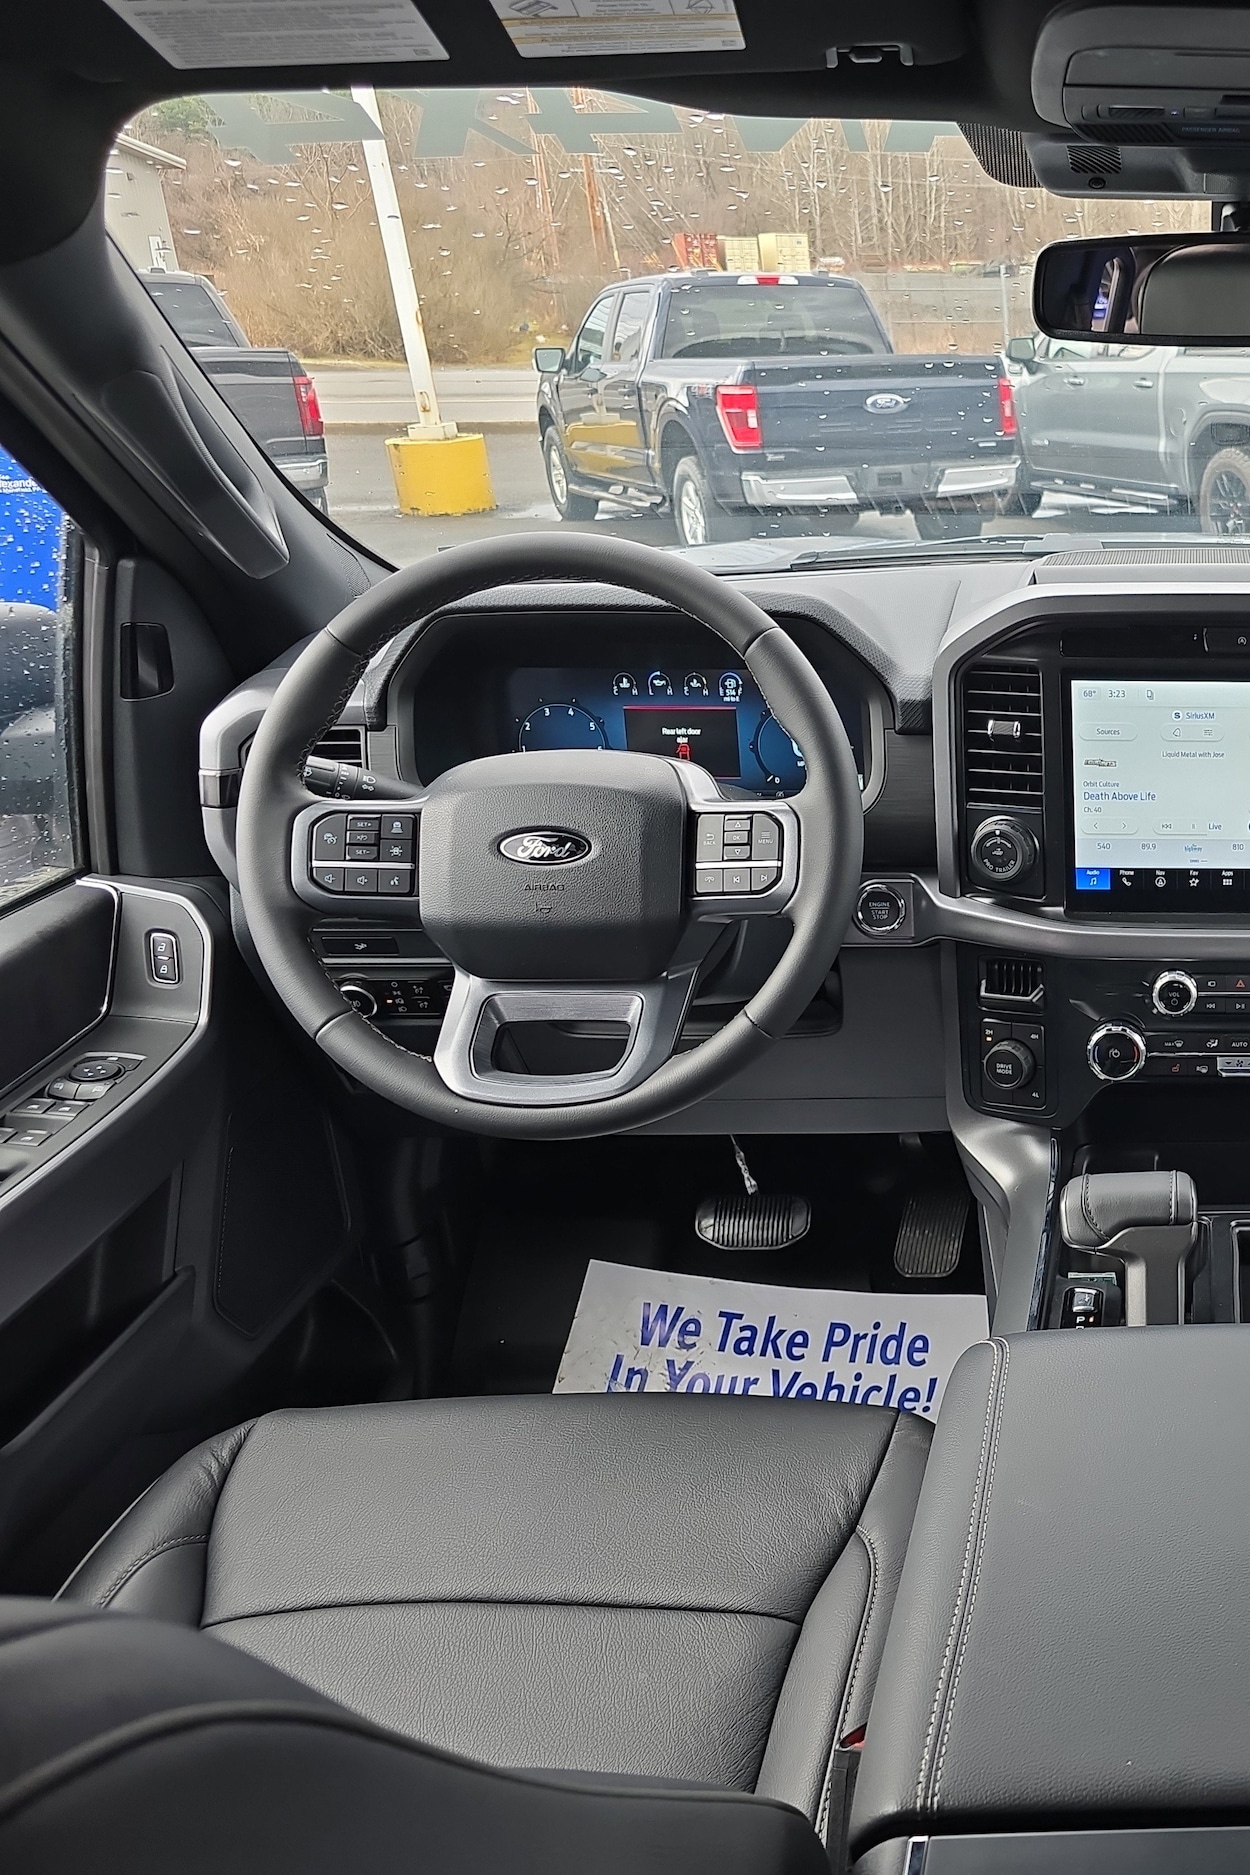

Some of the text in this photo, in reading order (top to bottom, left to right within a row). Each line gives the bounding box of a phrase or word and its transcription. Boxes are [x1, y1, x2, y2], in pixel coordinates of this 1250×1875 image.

[1108, 690, 1126, 698] 3:23
[544, 707, 551, 717] 3
[568, 707, 575, 717] 4
[1185, 711, 1215, 720] SiriusXM
[525, 722, 531, 731] 2
[589, 722, 596, 731] 5
[662, 727, 701, 736] Rear left door
[1096, 727, 1121, 736] Sources
[676, 736, 689, 744] ajar
[1162, 751, 1180, 759] Liquid
[1083, 791, 1157, 801] Death Above Life
[1208, 823, 1222, 831] Live
[516, 835, 571, 859] Ford
[1141, 843, 1157, 851] 89.9
[1232, 843, 1245, 851] 810
[983, 858, 1016, 873] PRO TRAILER
[523, 883, 566, 892] AIRBAG
[1076, 1315, 1086, 1324] P
[640, 1301, 931, 1369] We Take Pride
[606, 1353, 939, 1414] In Your Vehicle!
